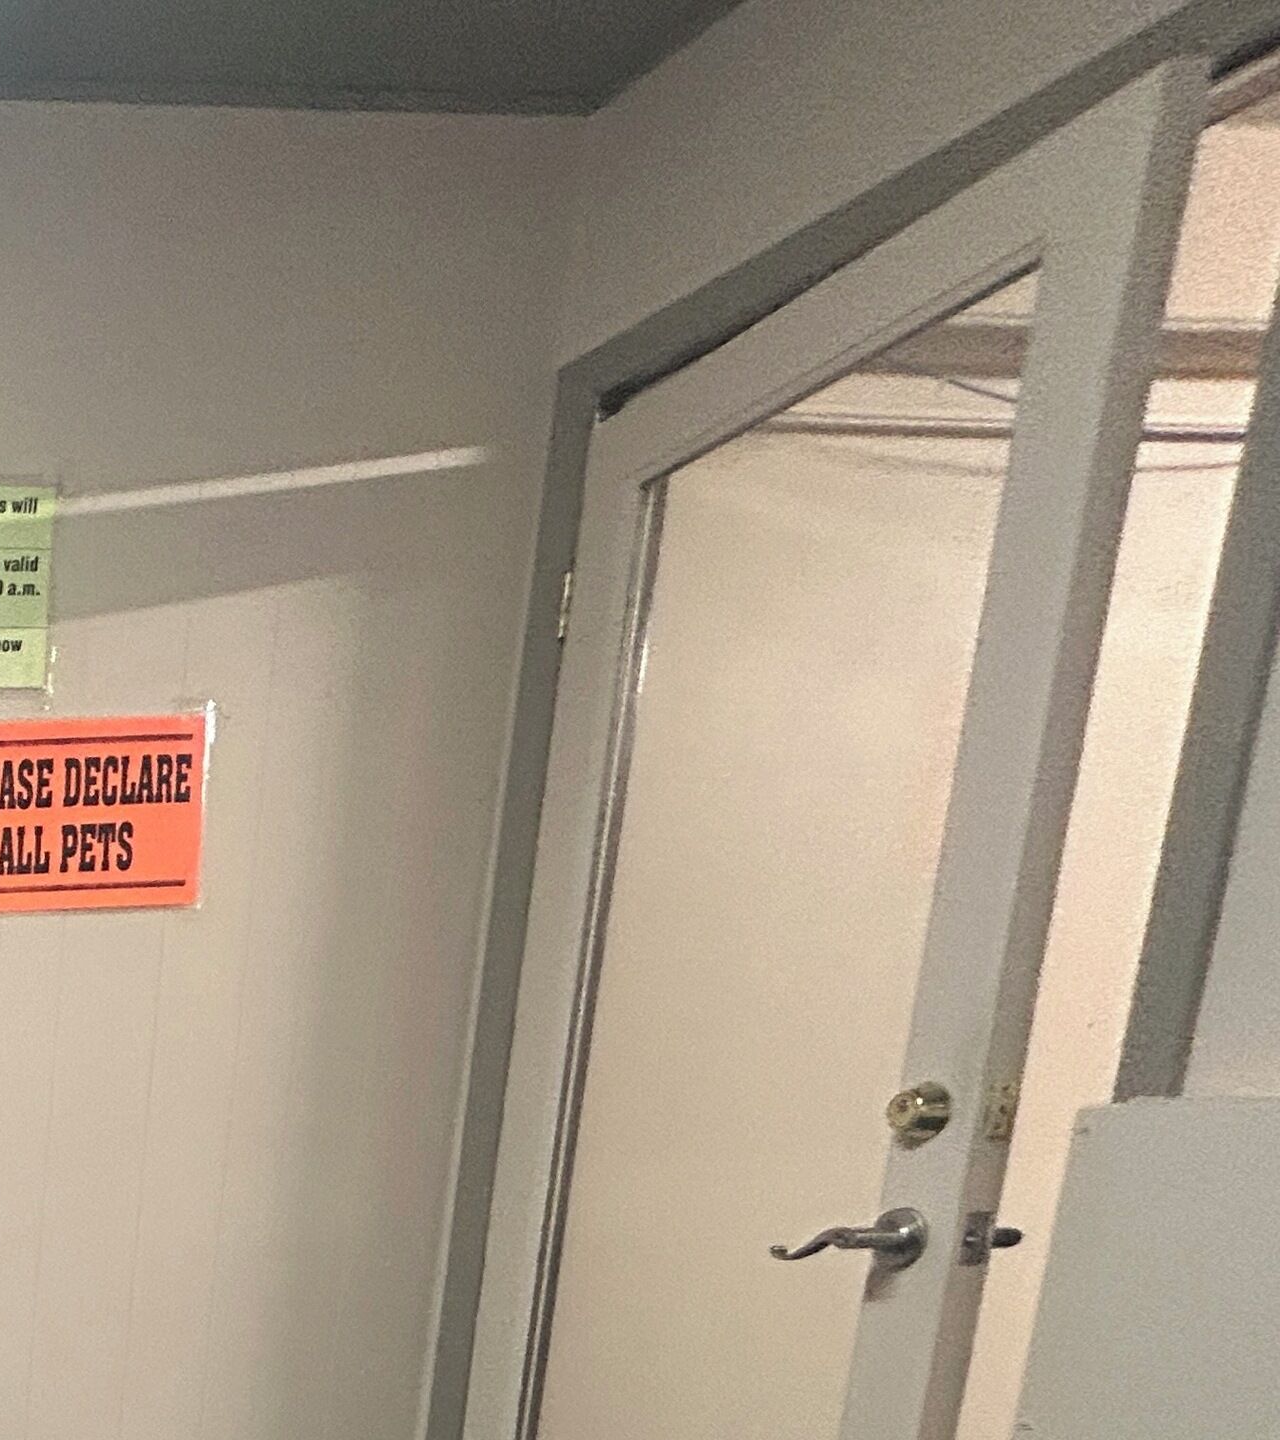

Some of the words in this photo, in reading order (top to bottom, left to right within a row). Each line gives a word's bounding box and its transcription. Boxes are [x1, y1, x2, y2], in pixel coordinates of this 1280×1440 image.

[11, 496, 38, 514] will
[3, 555, 39, 572] valid
[7, 582, 40, 597] a.m.
[62, 753, 193, 807] DECLARE
[59, 821, 134, 873] PETS
